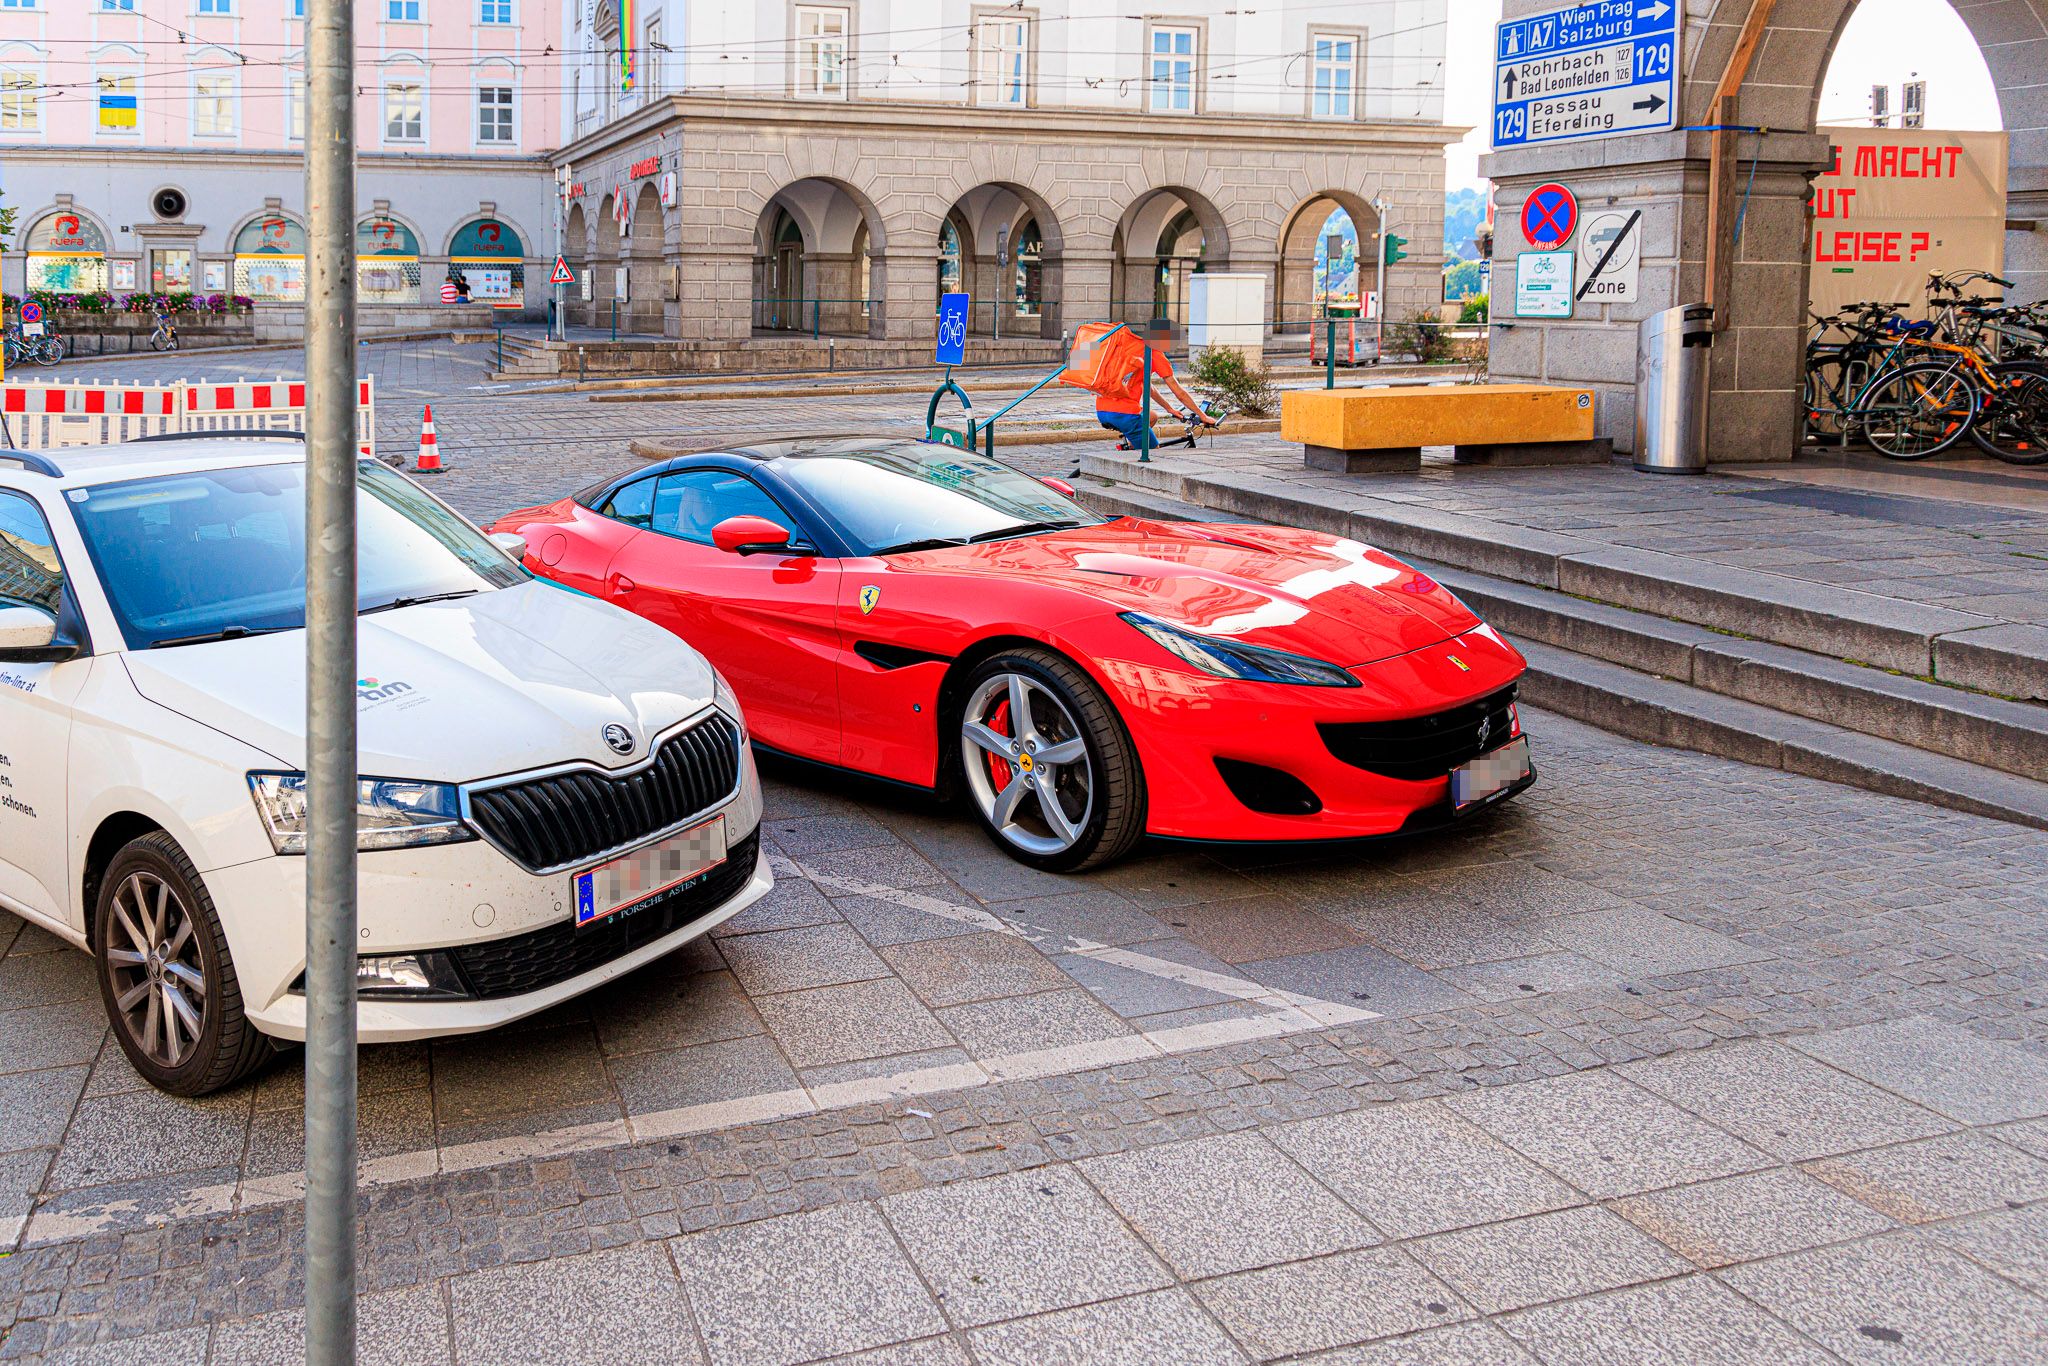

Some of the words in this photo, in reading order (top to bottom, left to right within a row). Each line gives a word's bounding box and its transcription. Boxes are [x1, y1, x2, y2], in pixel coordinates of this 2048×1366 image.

[1559, 7, 1595, 27] Wien
[1600, 1, 1633, 15] Prag
[1529, 20, 1554, 50] A7
[1559, 19, 1633, 45] Salzburg
[1521, 52, 1604, 78] Rohrbach
[1617, 48, 1631, 61] 127
[1636, 42, 1671, 78] 129
[1520, 80, 1541, 95] Bad
[1545, 69, 1609, 92] Leonfelden
[1616, 67, 1630, 80] 126
[1533, 97, 1601, 117] Passau
[1497, 107, 1525, 140] 129
[1532, 113, 1614, 134] Eferding
[1853, 145, 1963, 178] MACHT
[1808, 188, 1856, 219] UT
[50, 237, 84, 246] ruefa
[258, 241, 291, 249] ruefa
[368, 242, 399, 250] ruefa
[473, 243, 505, 252] ruefa
[1533, 240, 1558, 250] ANFANG
[1815, 231, 1902, 262] LEISE
[1587, 278, 1626, 294] Zone
[2, 794, 37, 818] schonen.
[583, 903, 590, 914] A
[620, 895, 663, 919] PORSCHE
[668, 878, 697, 898] ASTEN
